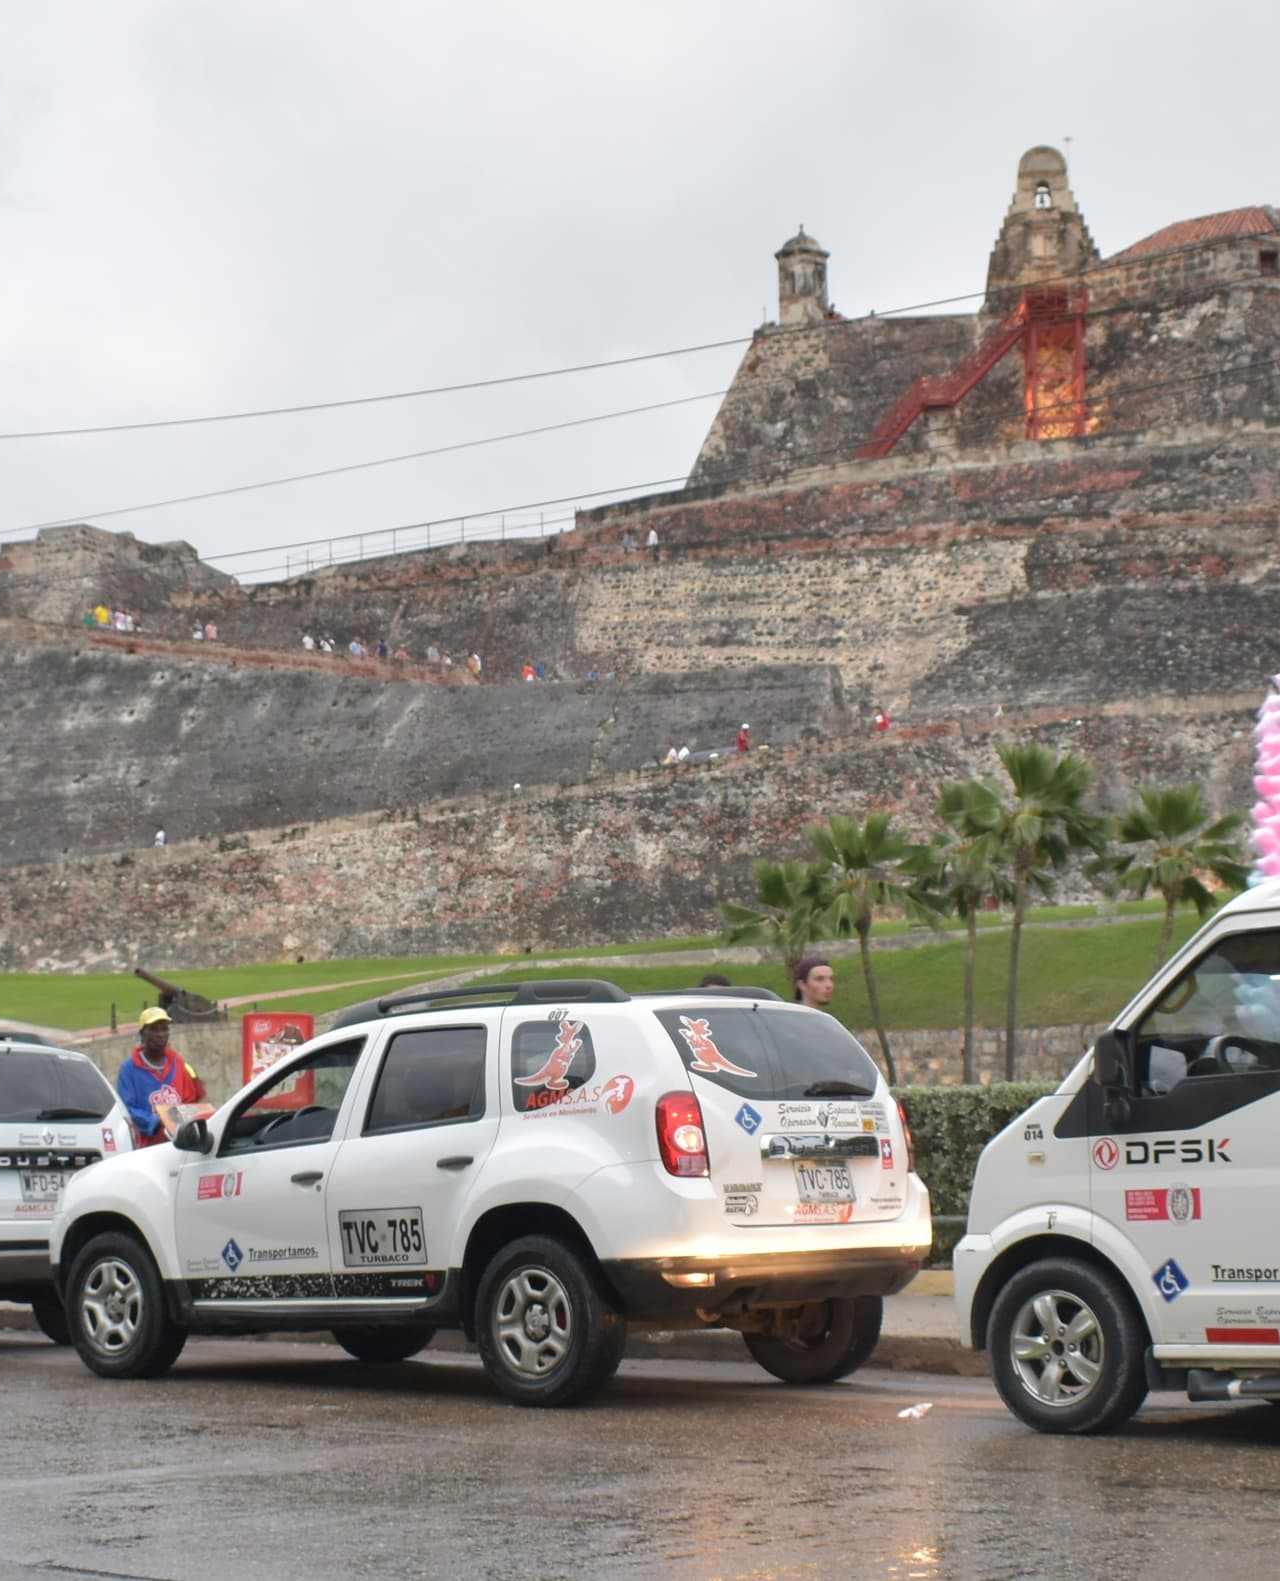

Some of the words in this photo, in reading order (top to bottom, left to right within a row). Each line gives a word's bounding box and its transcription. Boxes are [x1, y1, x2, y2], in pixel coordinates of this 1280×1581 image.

[1024, 1129, 1044, 1141] 014
[1125, 1138, 1232, 1165] DFSK
[342, 1220, 379, 1255] TVC
[387, 1218, 422, 1253] 785
[360, 1254, 410, 1264] TURBACO
